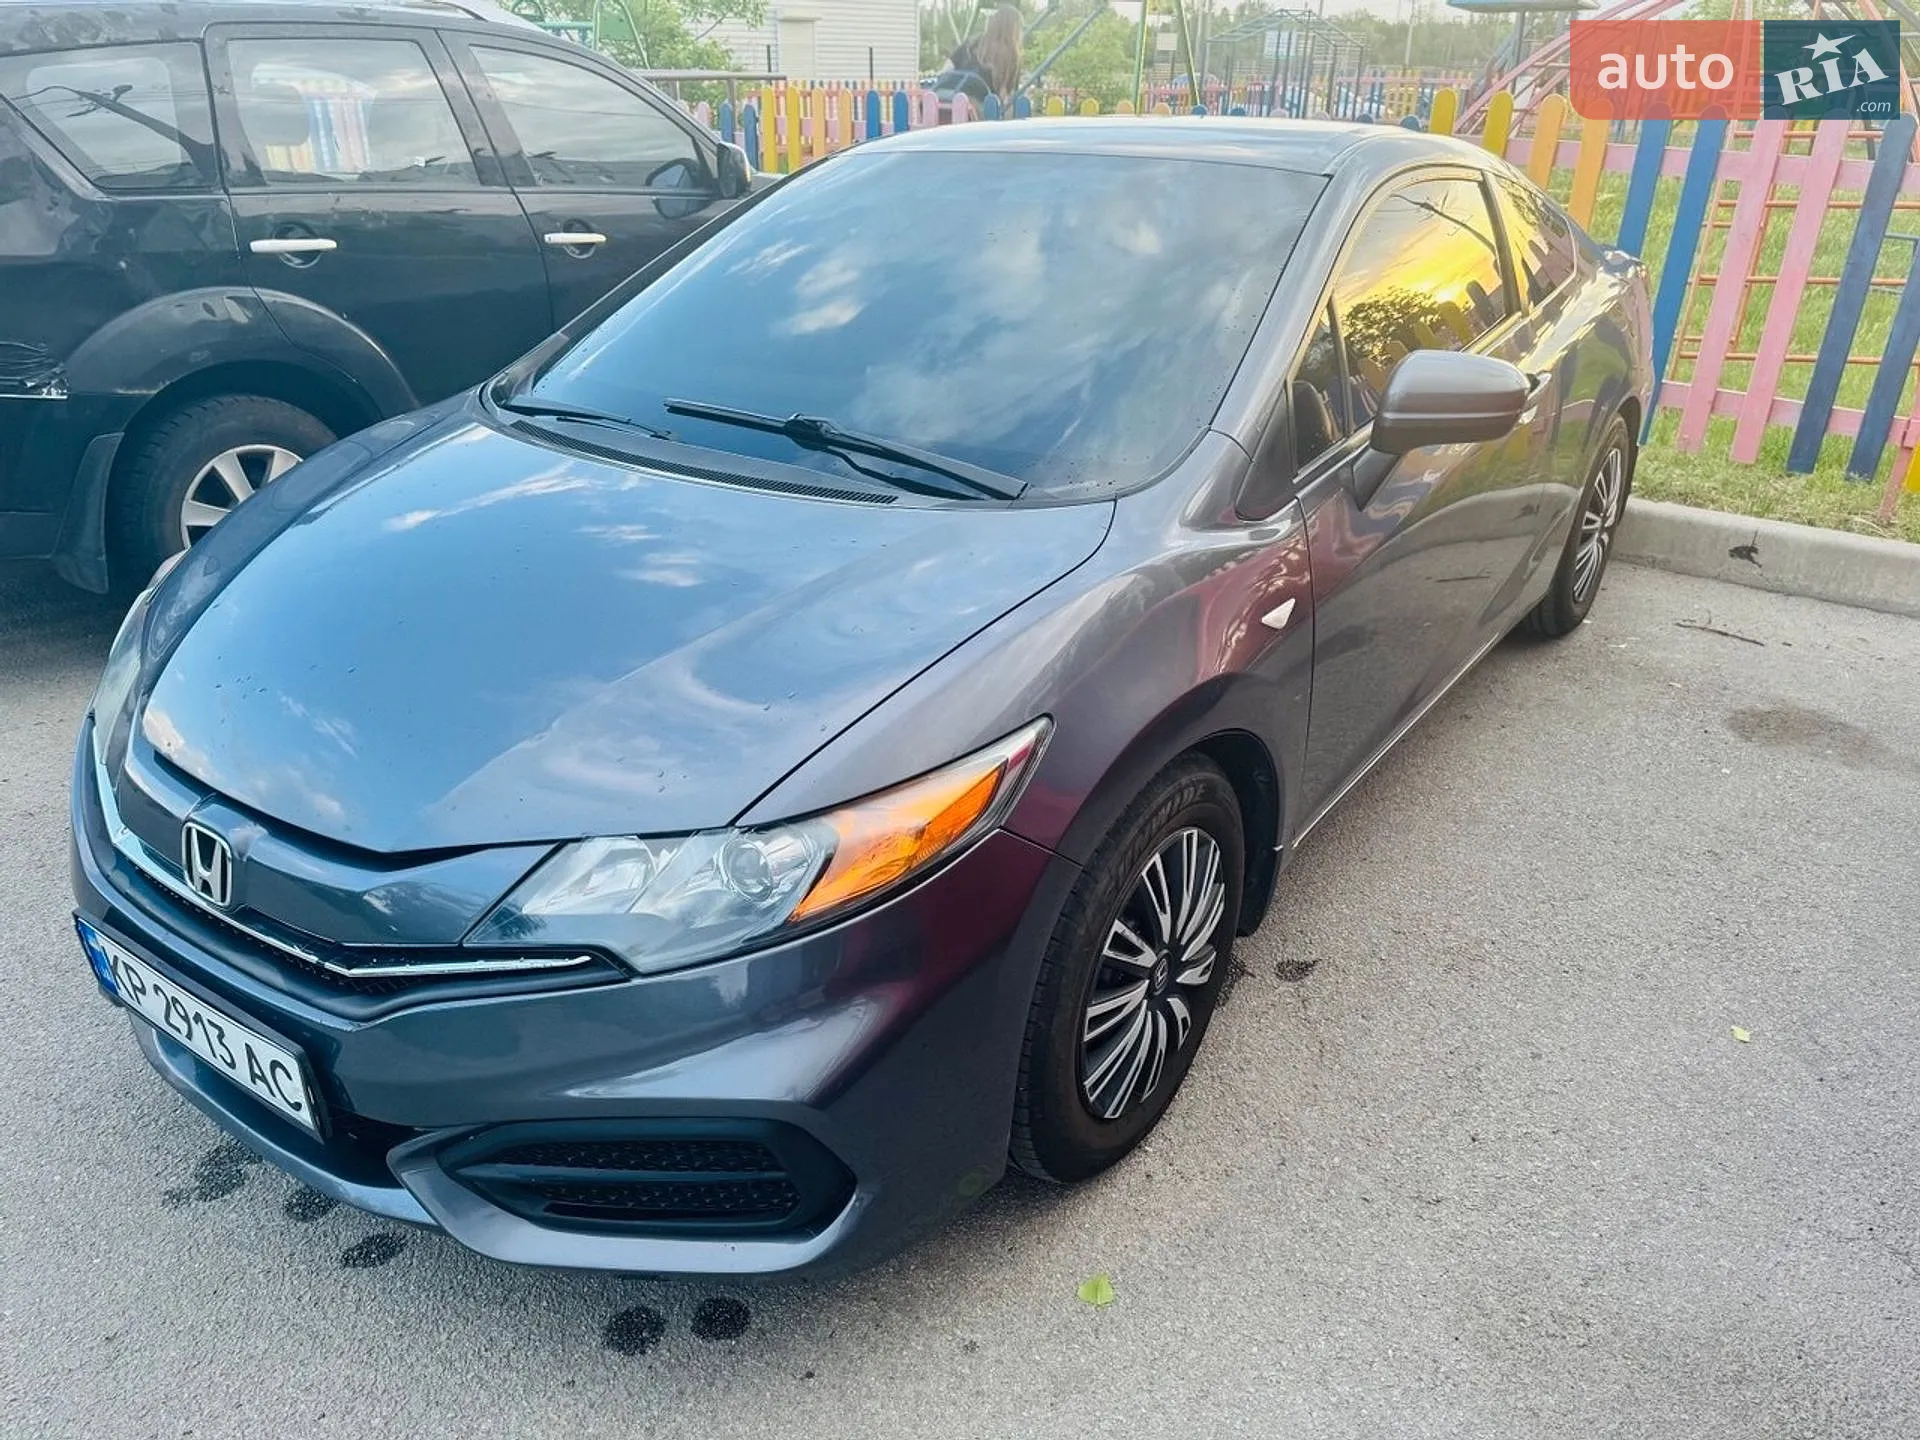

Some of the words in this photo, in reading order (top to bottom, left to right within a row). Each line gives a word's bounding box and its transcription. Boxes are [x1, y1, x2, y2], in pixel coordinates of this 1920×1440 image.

[102, 946, 147, 1006] KP
[154, 984, 237, 1070] 2913
[245, 1043, 302, 1112] AC
